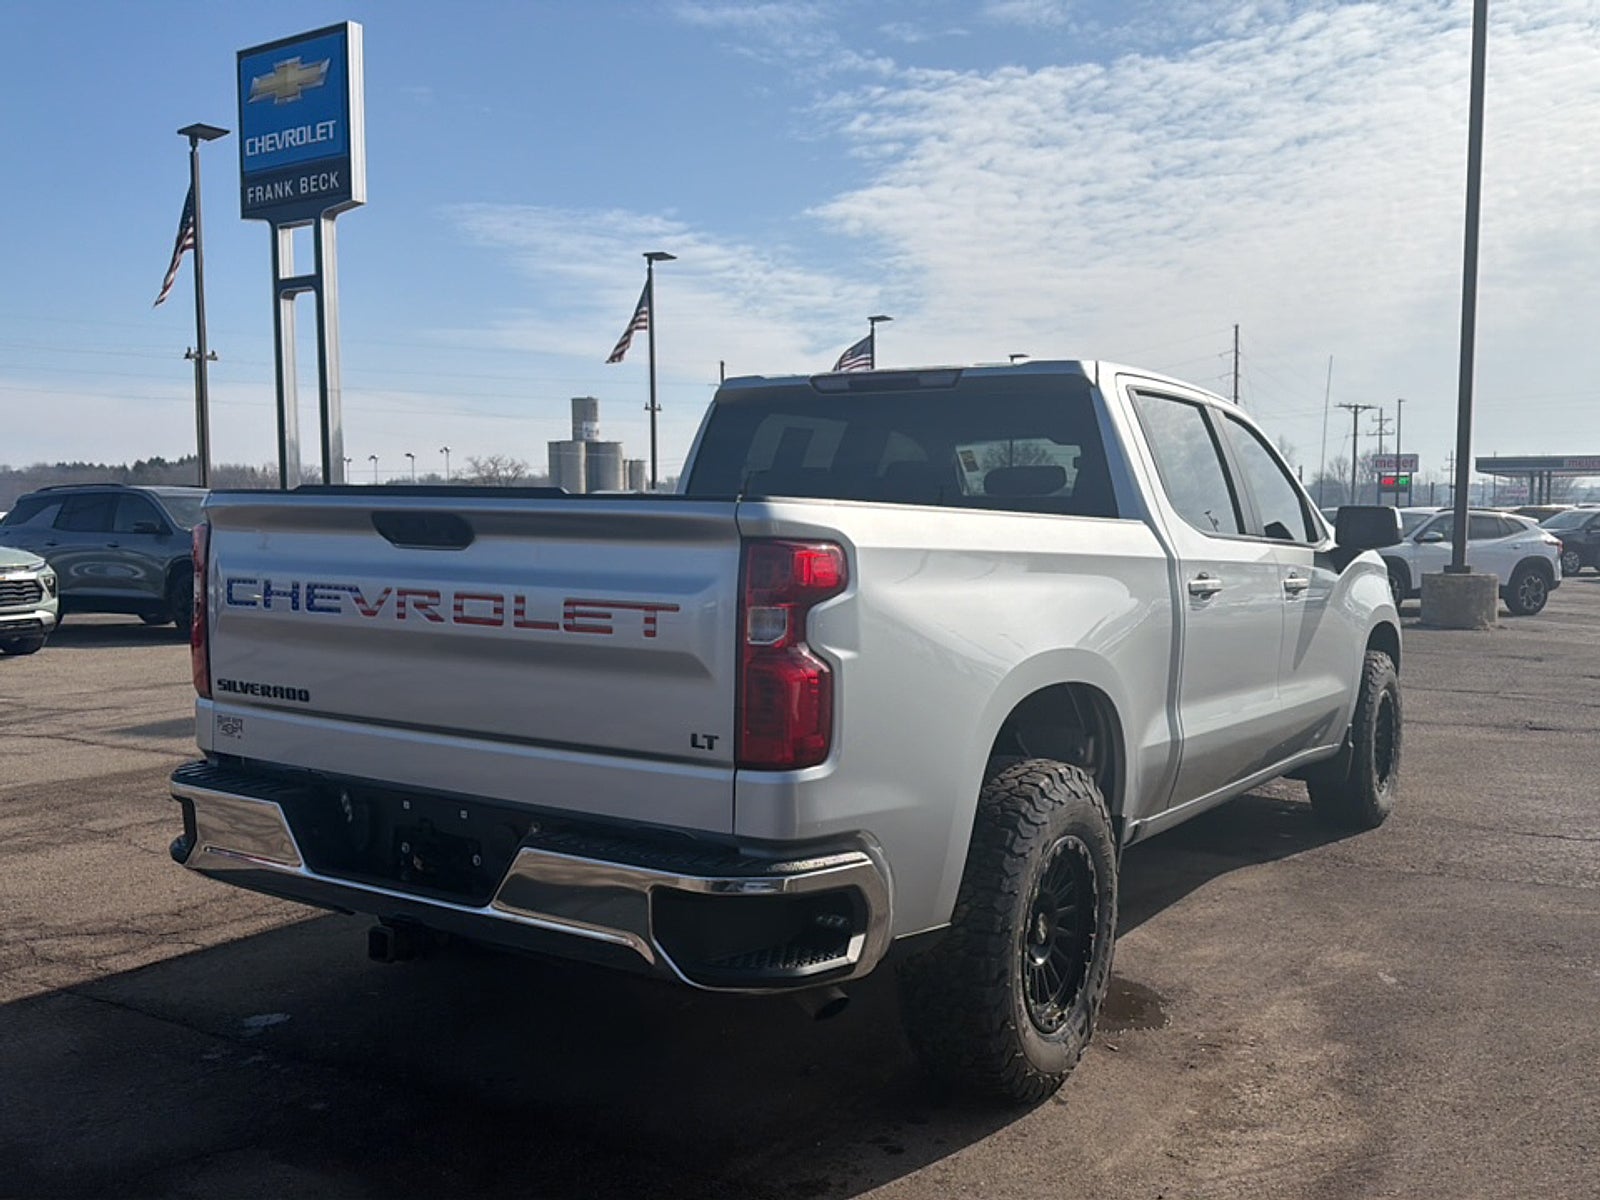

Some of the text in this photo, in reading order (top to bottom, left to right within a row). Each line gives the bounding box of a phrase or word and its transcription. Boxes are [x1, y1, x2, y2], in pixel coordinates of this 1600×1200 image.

[246, 120, 336, 157] CHEVROLET
[247, 172, 339, 204] FRANK BECK
[1375, 458, 1416, 469] meer
[226, 577, 681, 638] CHEVROLET
[217, 679, 310, 702] SILVERADO
[690, 733, 719, 750] LT
